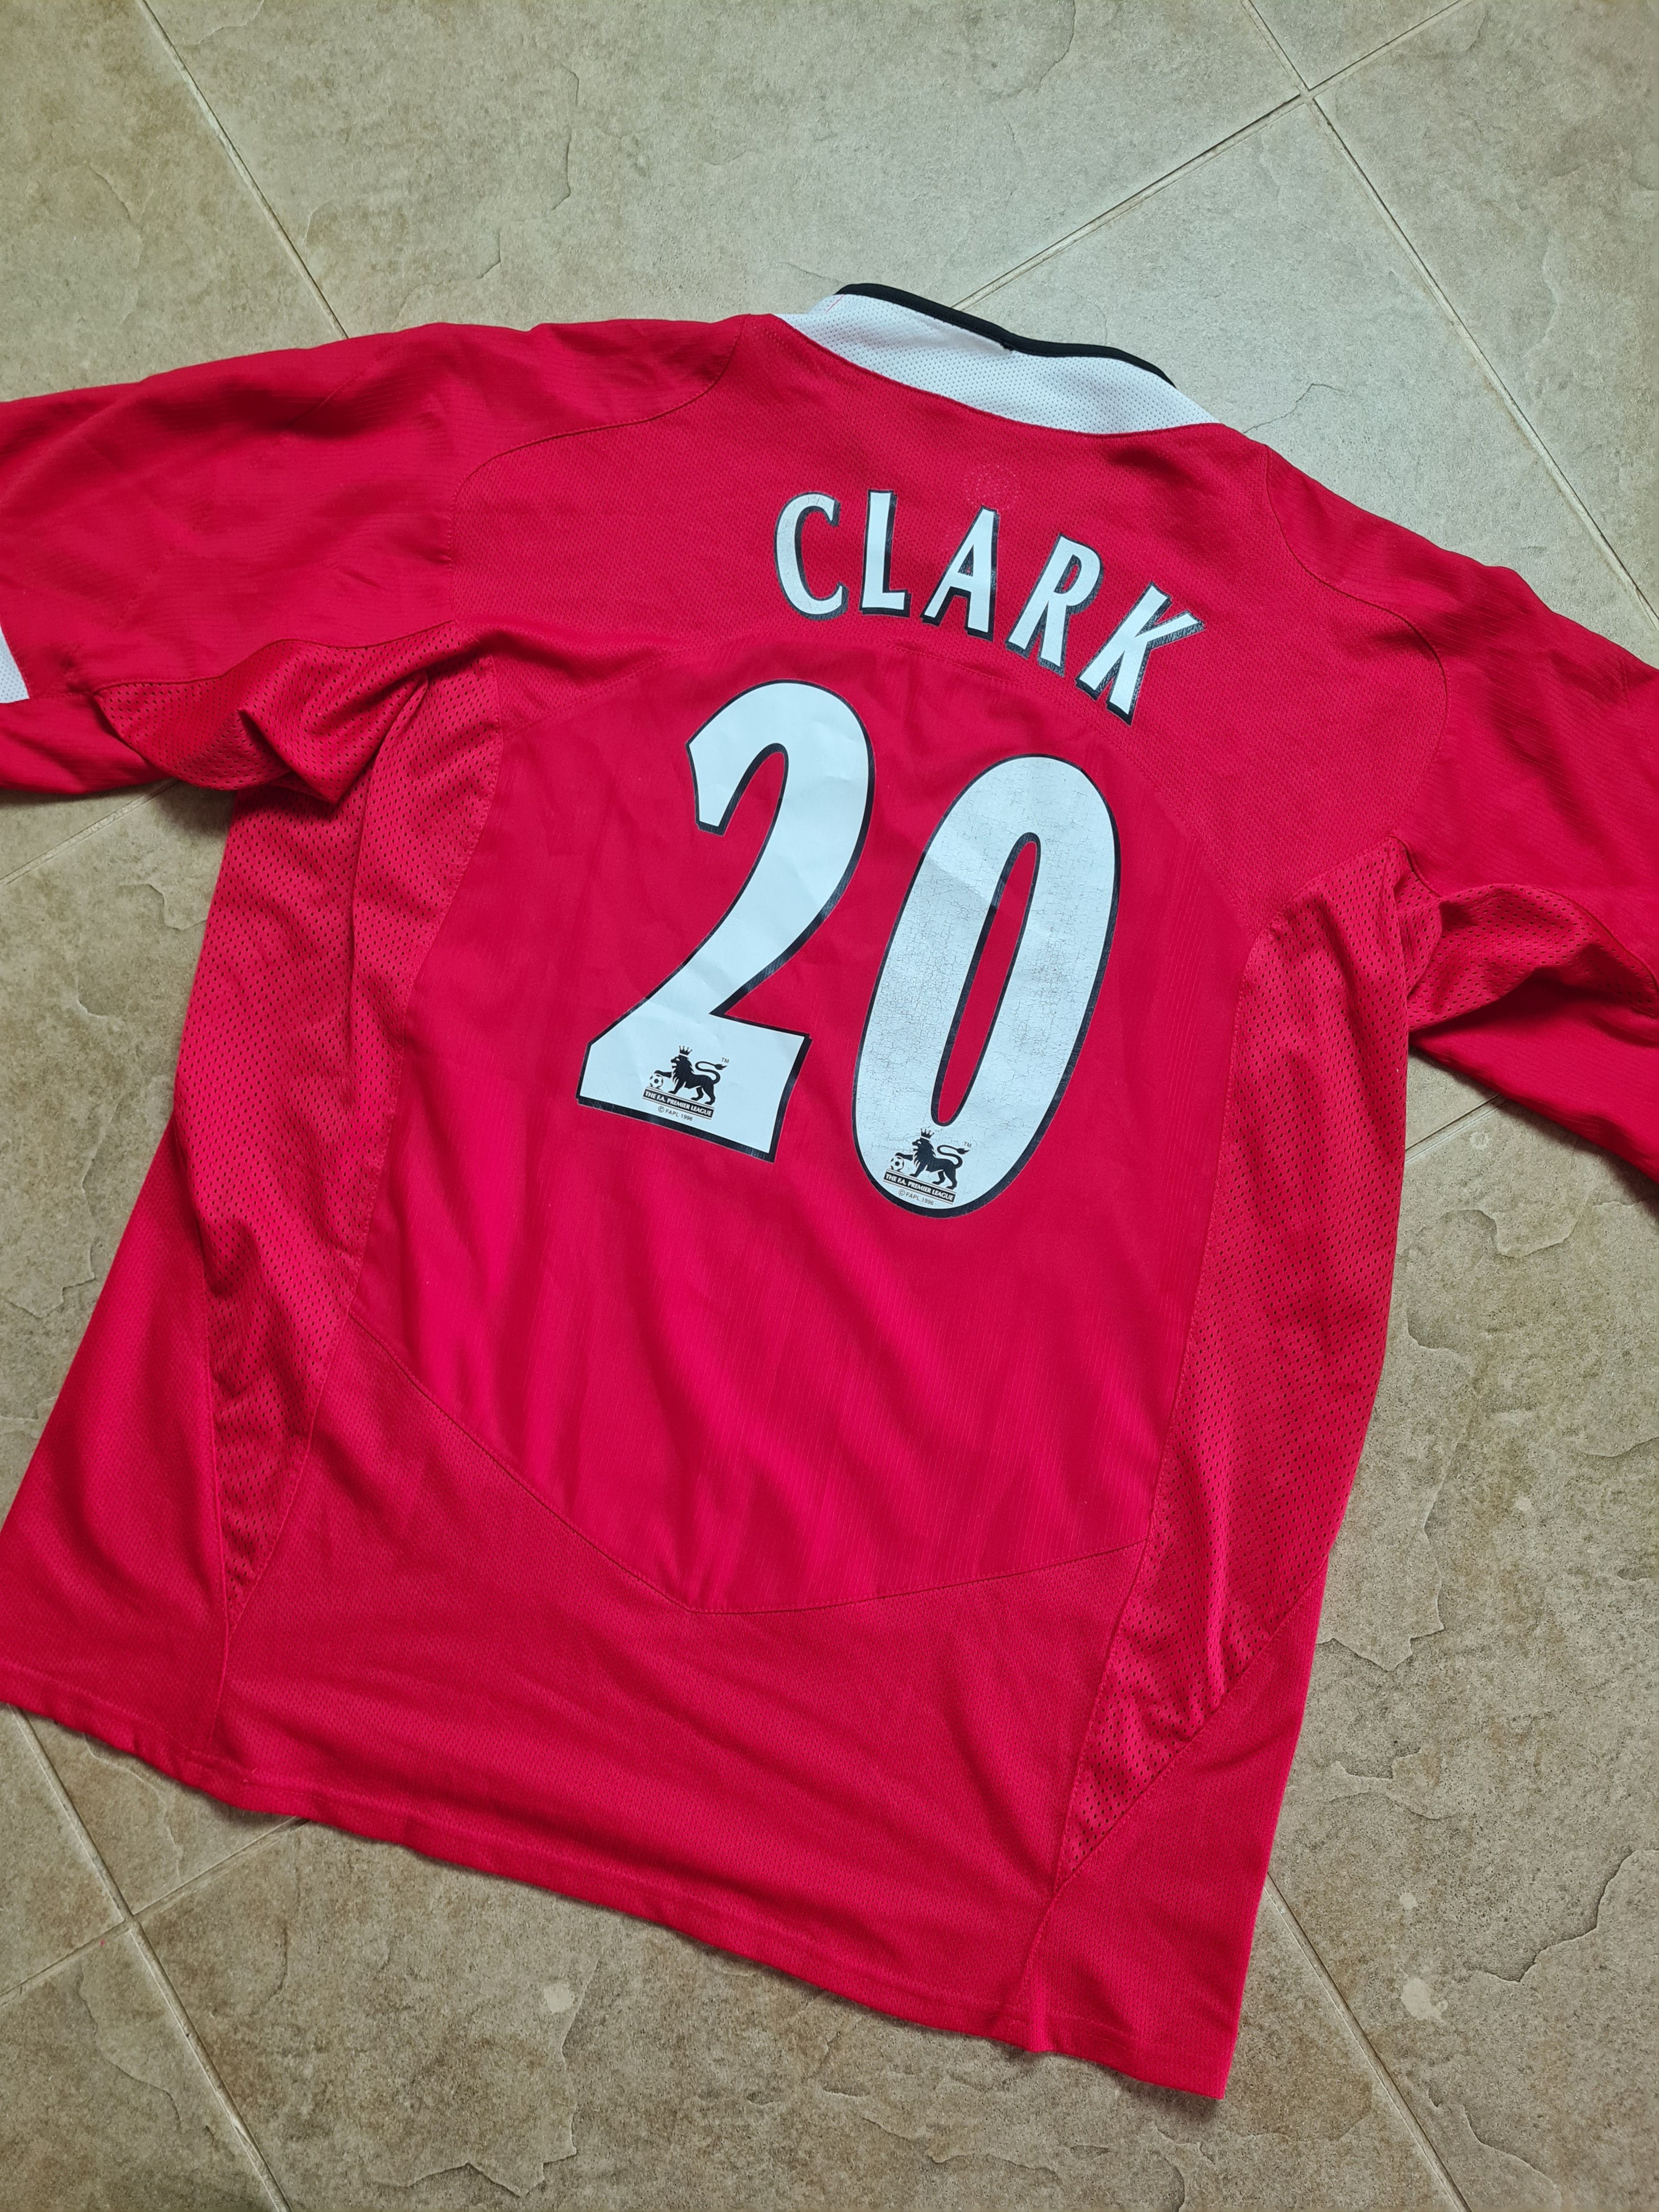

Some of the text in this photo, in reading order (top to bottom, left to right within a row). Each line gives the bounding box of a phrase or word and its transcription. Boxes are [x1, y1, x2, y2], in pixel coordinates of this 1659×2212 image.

[774, 489, 1206, 726] CLARK
[575, 679, 1121, 1218] 20
[667, 1099, 690, 1109] PREMIER
[691, 1105, 712, 1116] LEAGUE
[886, 1174, 897, 1182] THE
[908, 1181, 931, 1192] PREMIER
[932, 1189, 954, 1201] LEAGUE
[921, 1197, 934, 1205] 1996
